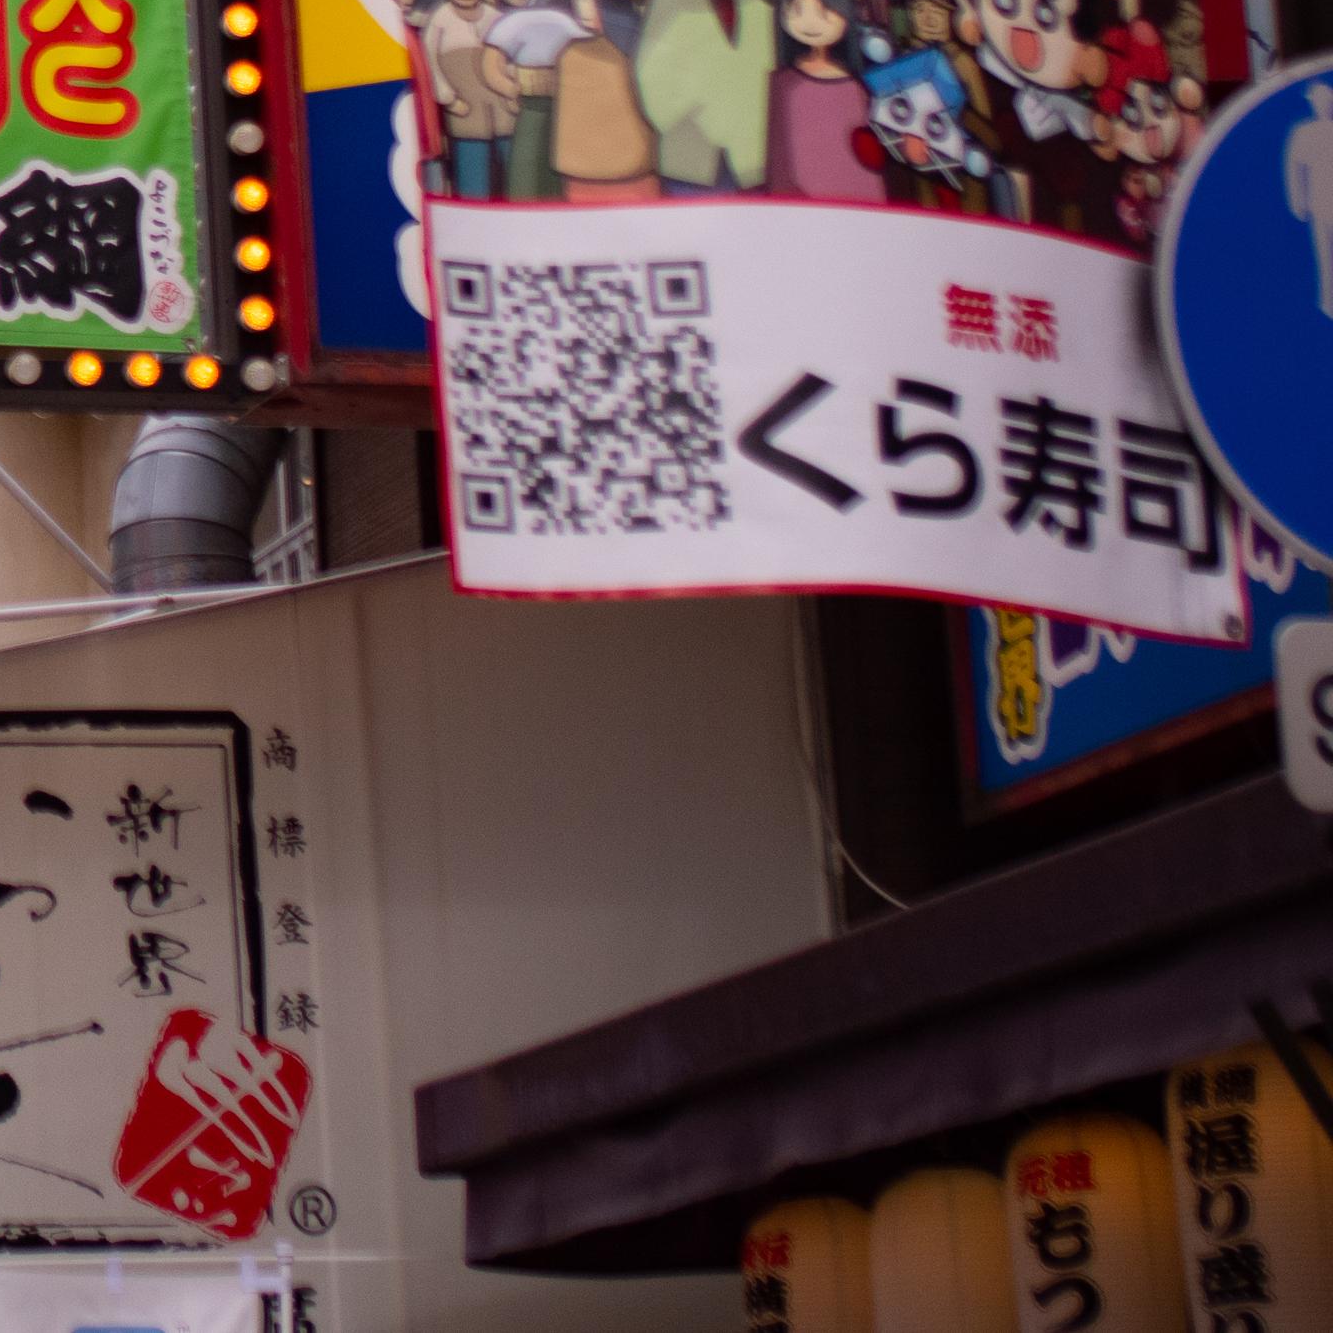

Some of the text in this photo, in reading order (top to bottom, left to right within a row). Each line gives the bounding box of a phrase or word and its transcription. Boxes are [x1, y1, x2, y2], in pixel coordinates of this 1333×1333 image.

[942, 282, 1061, 363] 無添
[737, 371, 1230, 575] くら寿司
[106, 784, 207, 998] 新世界
[261, 726, 319, 1034] 商標登録
